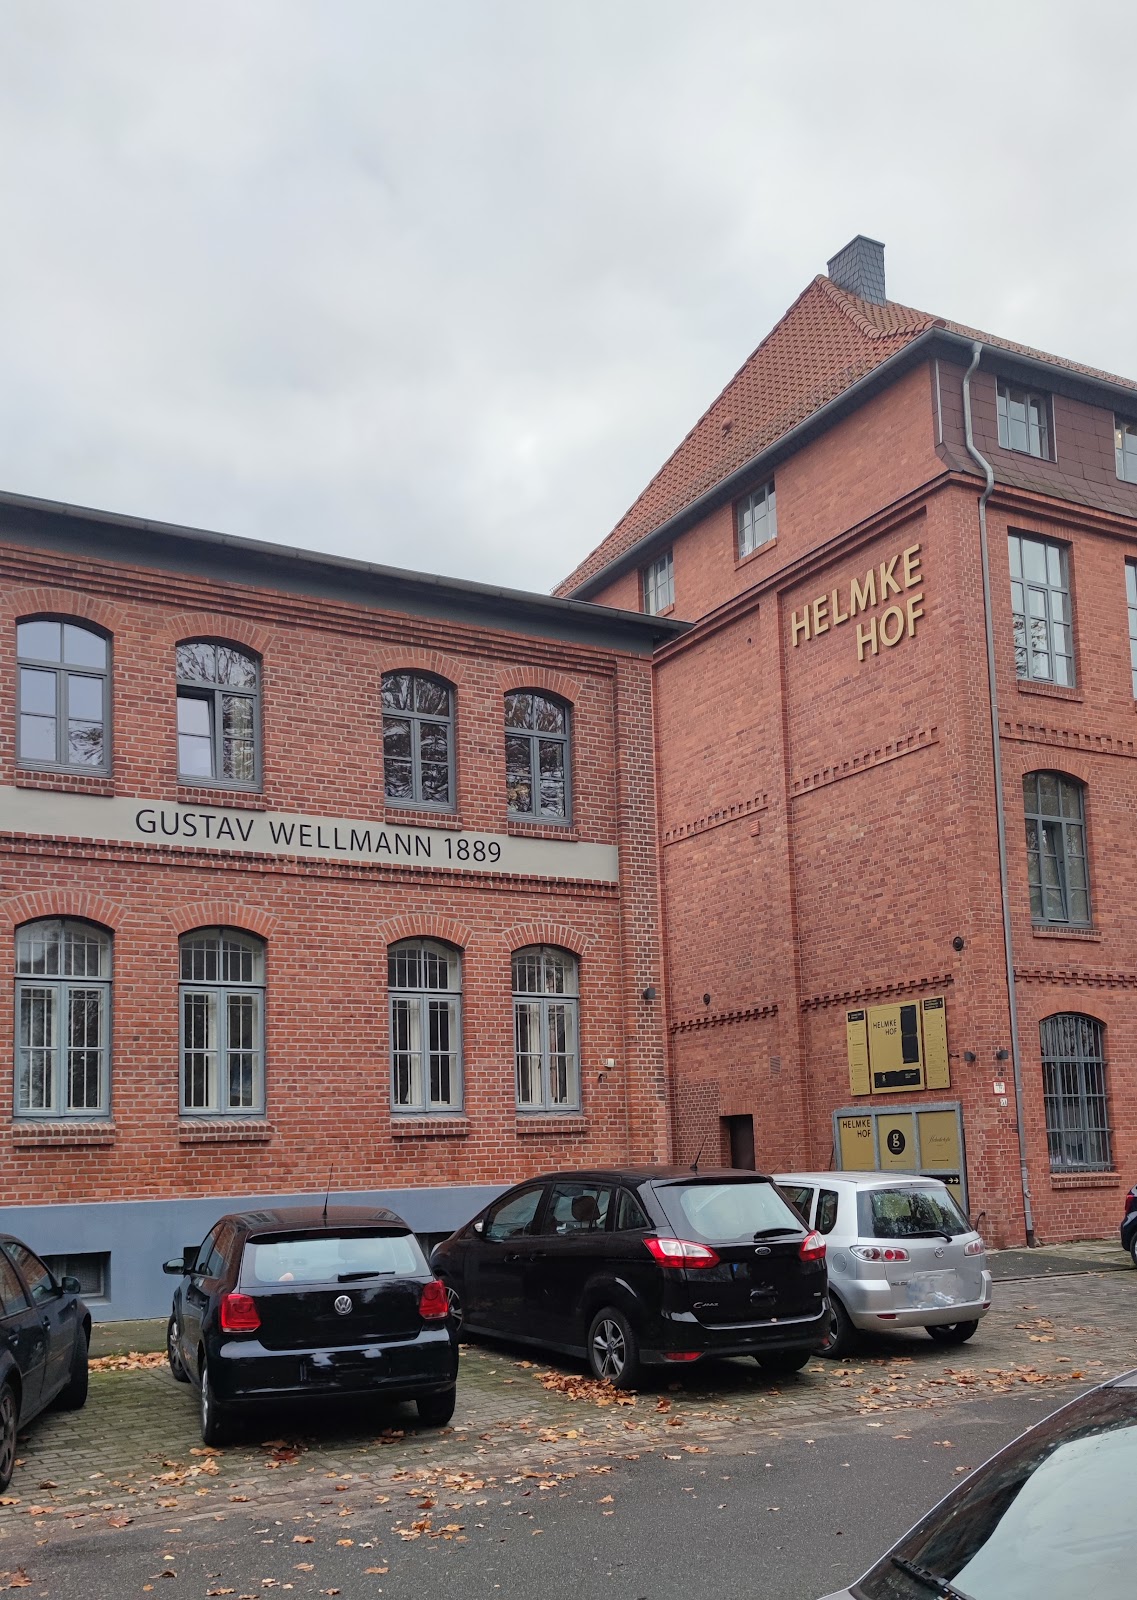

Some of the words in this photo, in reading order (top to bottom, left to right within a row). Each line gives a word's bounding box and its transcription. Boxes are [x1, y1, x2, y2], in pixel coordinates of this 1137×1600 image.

[791, 543, 923, 648] HELMKE
[856, 592, 925, 661] HOF
[135, 809, 255, 842] GUSTAV
[269, 821, 432, 857] WELLMANN
[444, 838, 502, 863] 1889
[873, 1019, 897, 1028] HELMKE
[885, 1028, 898, 1036] HOF
[842, 1119, 871, 1129] HELMKE
[857, 1129, 871, 1138] HOF
